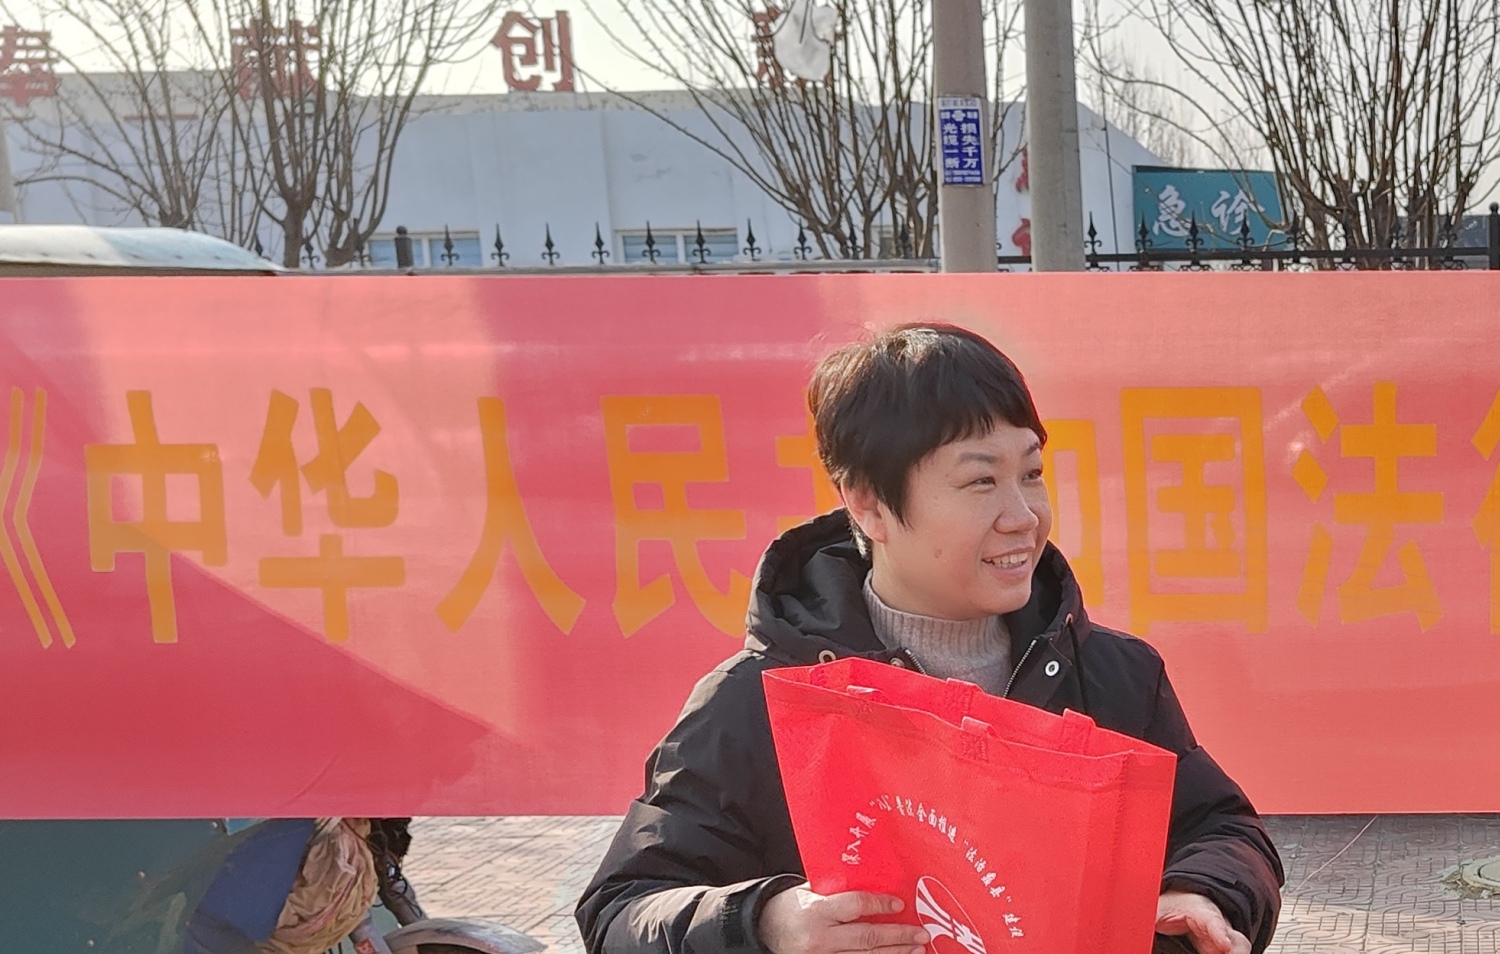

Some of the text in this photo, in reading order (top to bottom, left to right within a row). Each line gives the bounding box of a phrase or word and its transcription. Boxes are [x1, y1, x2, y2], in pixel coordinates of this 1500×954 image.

[960, 122, 980, 169] 损失千万
[1152, 184, 1265, 237] 急诊
